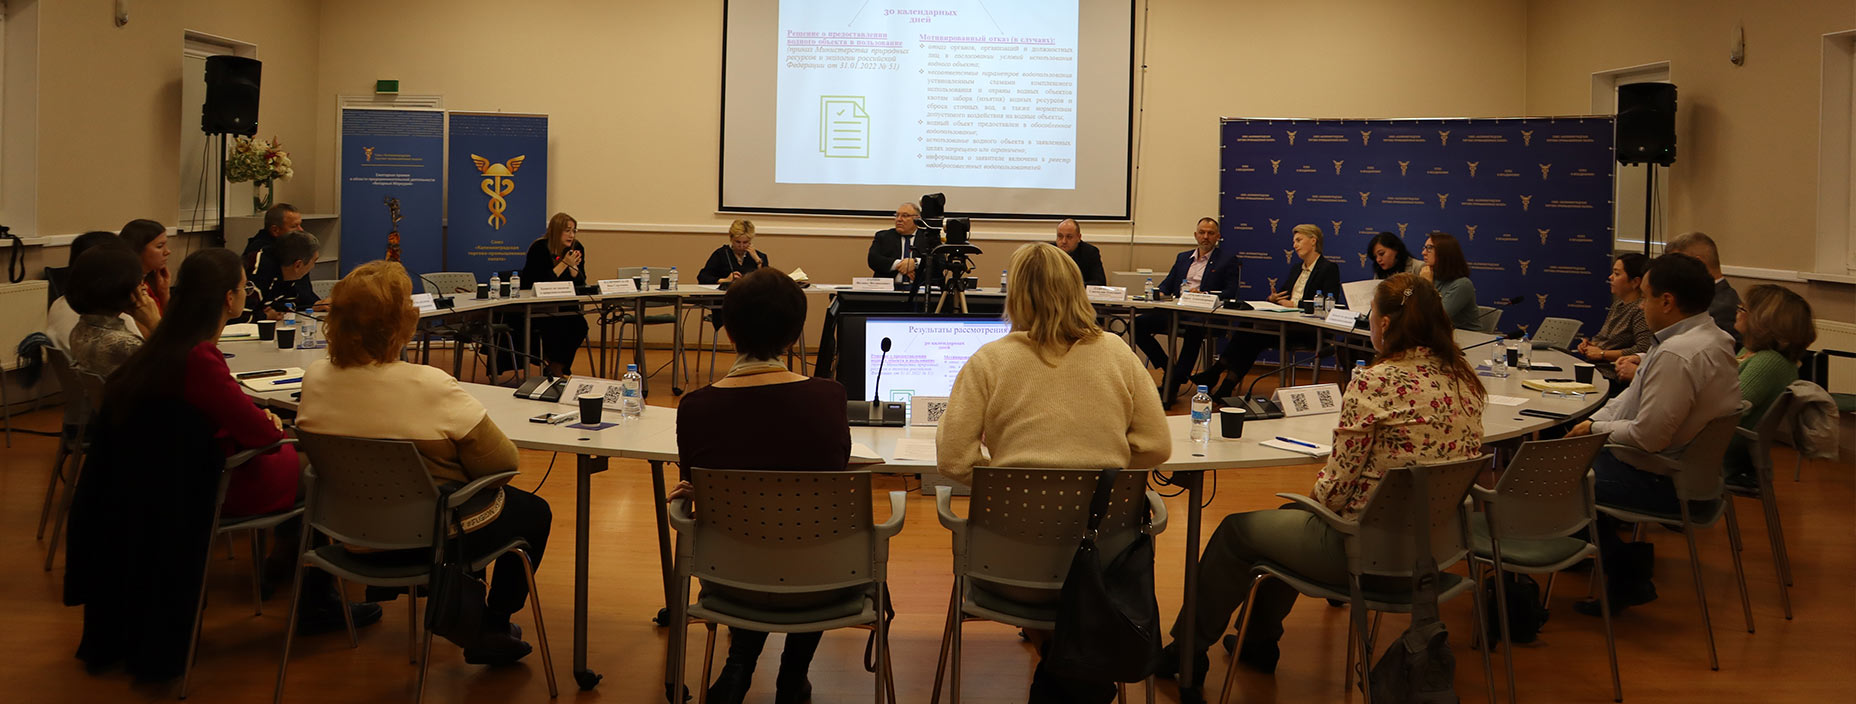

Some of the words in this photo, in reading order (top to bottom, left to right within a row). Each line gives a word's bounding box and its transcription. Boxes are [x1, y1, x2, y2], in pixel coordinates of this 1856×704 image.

[897, 8, 958, 17] календарных
[909, 16, 932, 24] дней
[786, 29, 820, 38] Решение
[828, 31, 888, 39] предоставлении
[919, 33, 987, 43] Мотивированный
[908, 325, 952, 336] Результаты
[954, 326, 1008, 336] рассмотрения
